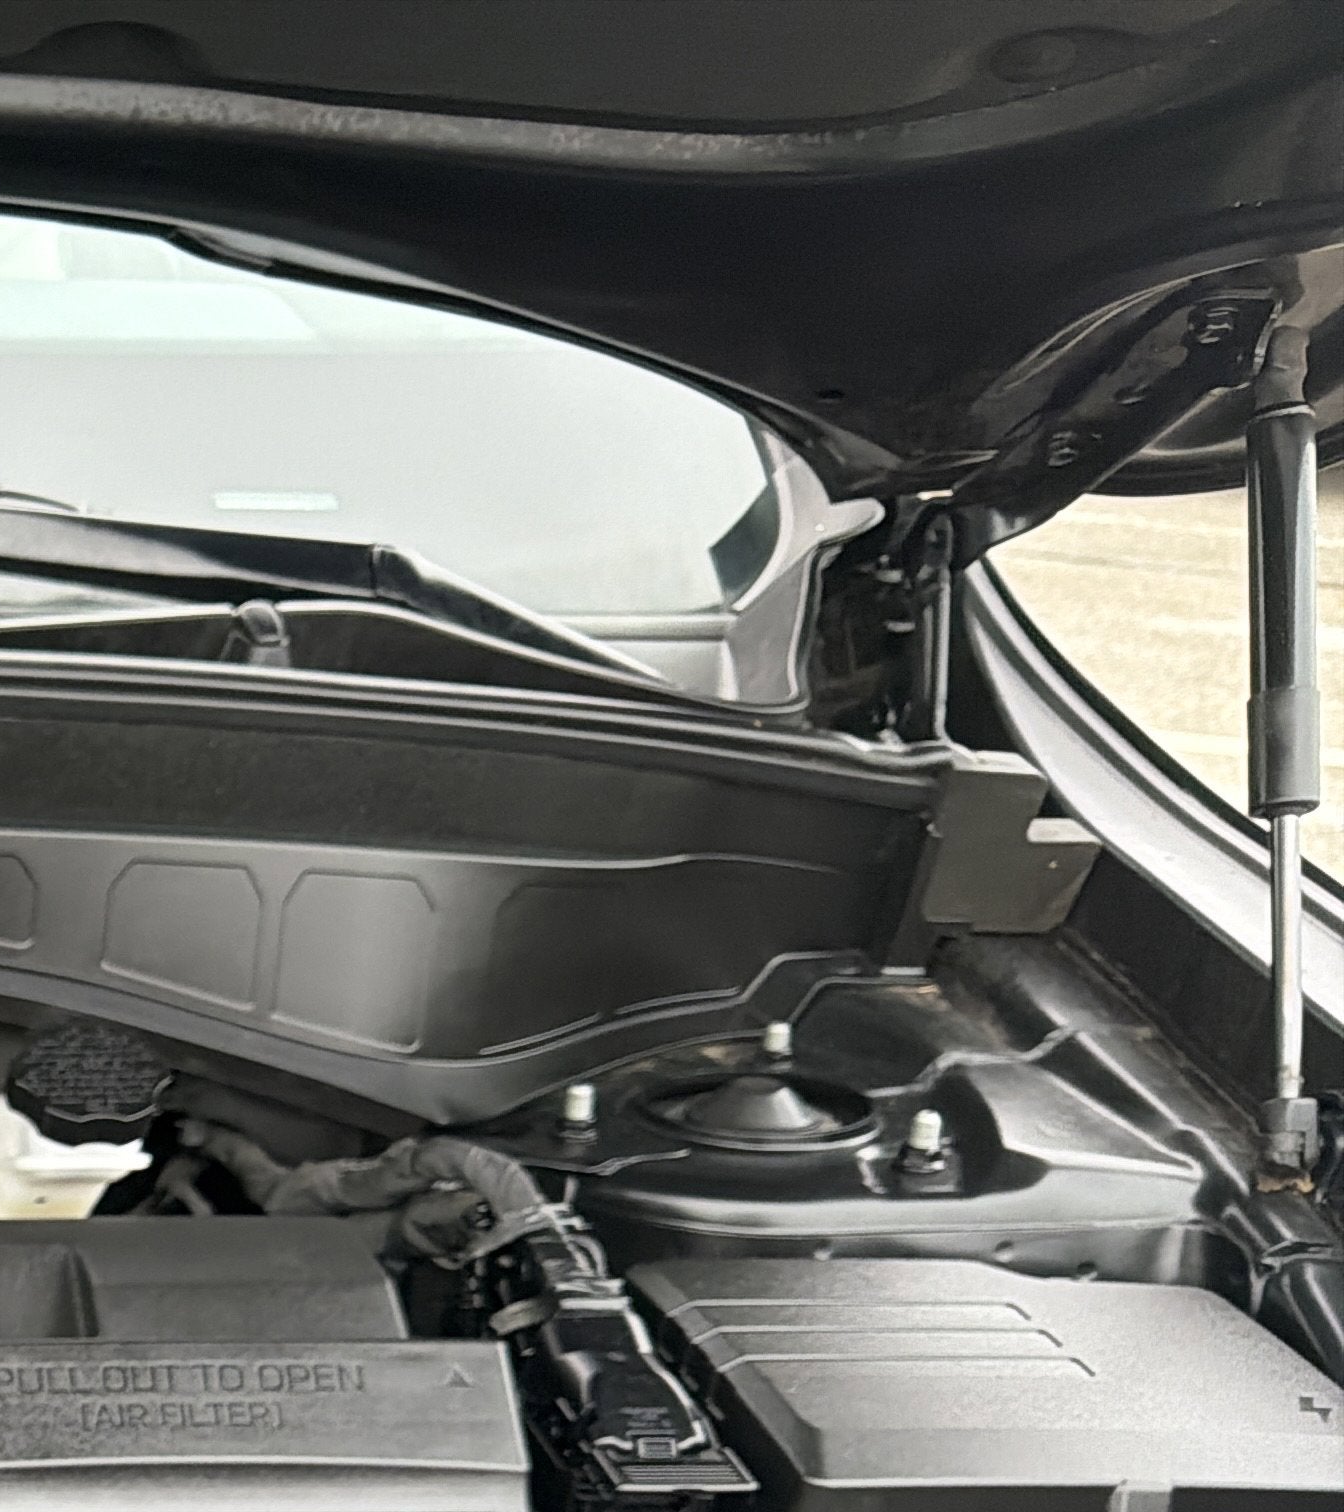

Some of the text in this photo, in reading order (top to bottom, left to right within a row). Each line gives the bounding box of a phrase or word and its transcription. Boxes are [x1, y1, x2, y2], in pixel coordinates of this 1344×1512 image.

[101, 1363, 179, 1394] OUT
[191, 1363, 245, 1392] TO
[257, 1363, 366, 1393] OPEN
